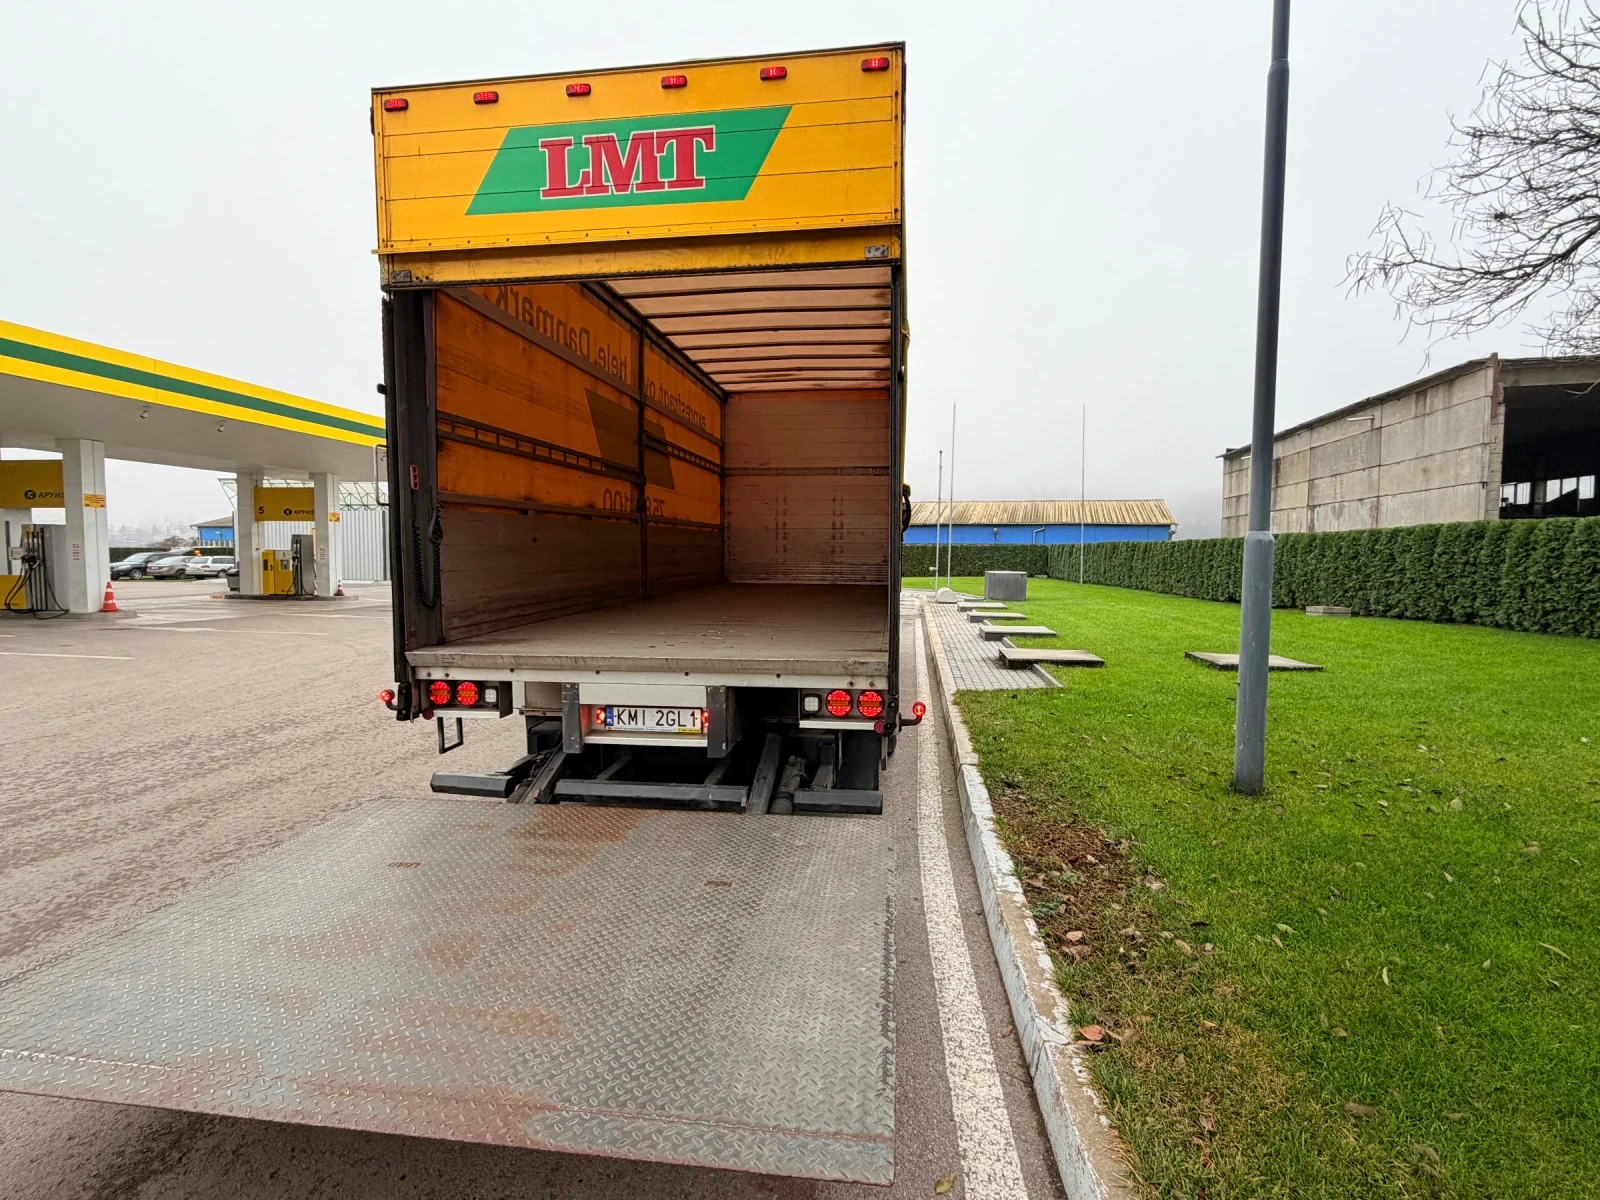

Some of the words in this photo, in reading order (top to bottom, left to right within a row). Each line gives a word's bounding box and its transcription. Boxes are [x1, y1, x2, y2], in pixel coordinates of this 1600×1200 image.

[538, 124, 716, 200] LMT
[258, 506, 265, 515] 5
[617, 708, 646, 726] KMI
[655, 709, 696, 727] 2GL1
